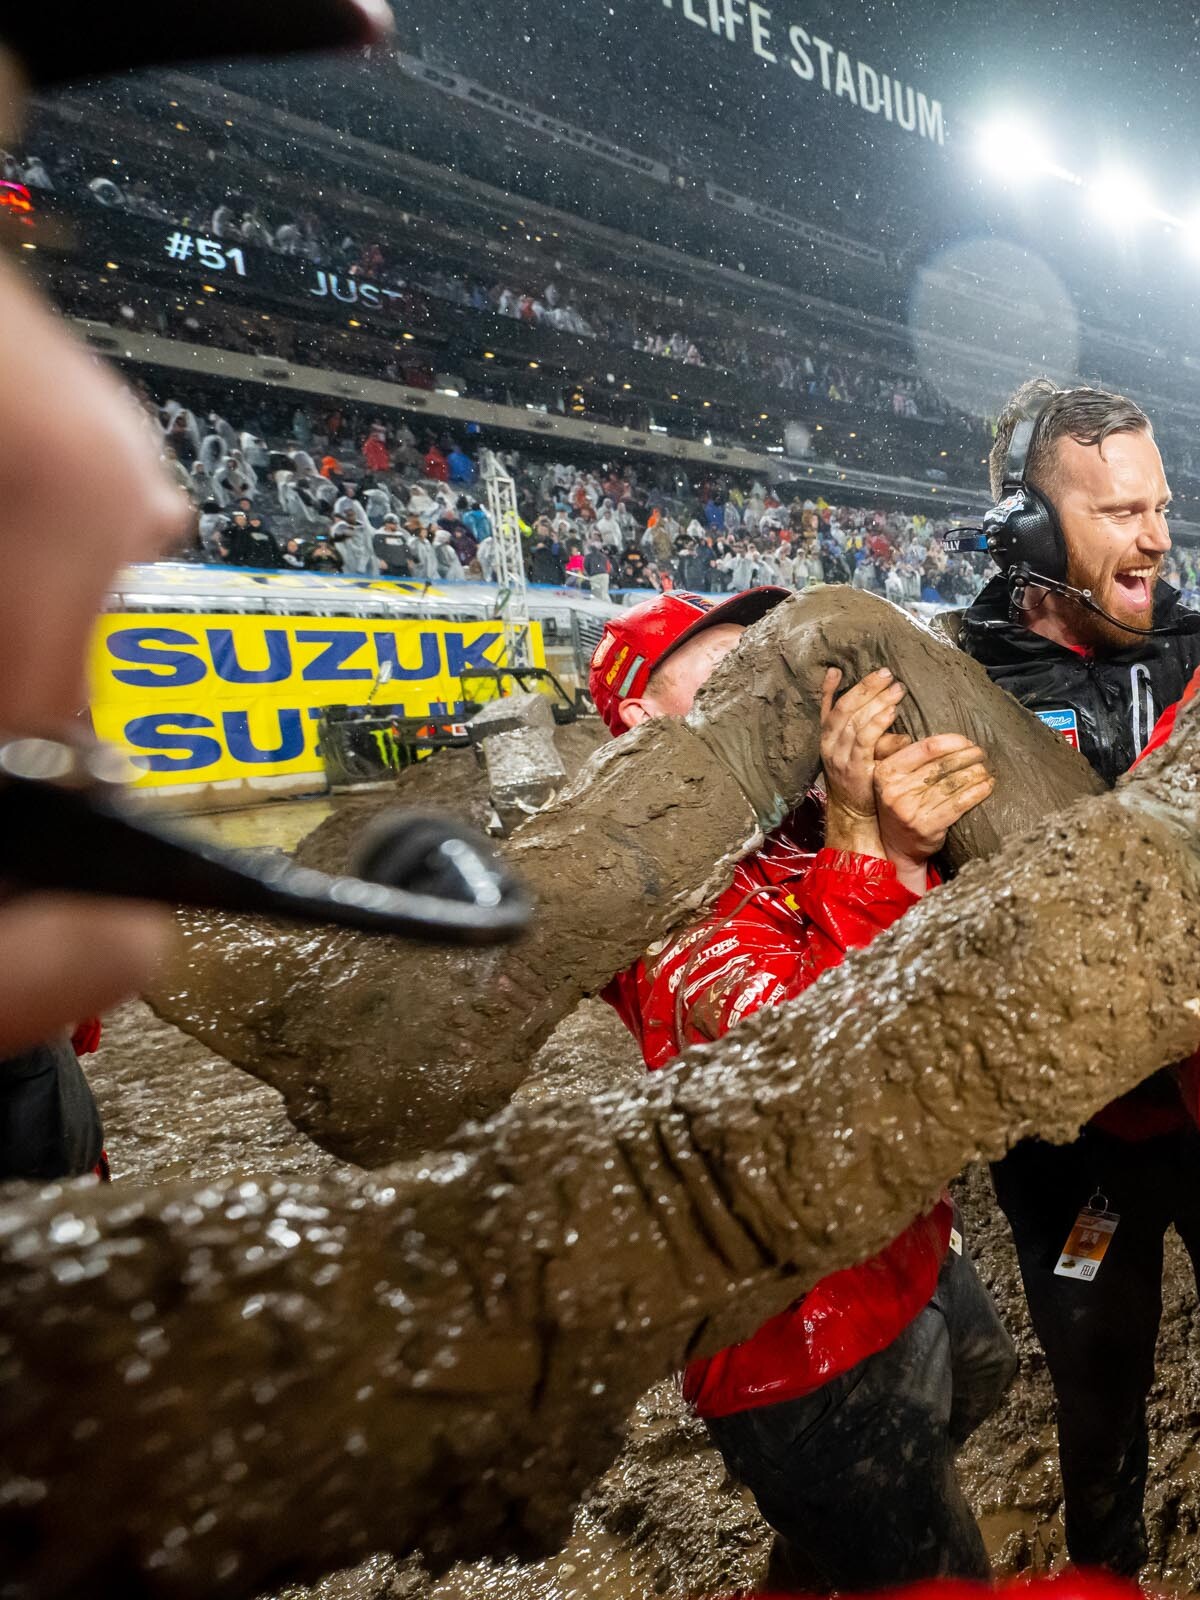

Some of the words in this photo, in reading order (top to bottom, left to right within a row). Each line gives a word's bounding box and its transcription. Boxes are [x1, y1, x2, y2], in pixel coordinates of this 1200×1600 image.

[663, 0, 778, 64] LIFE
[789, 25, 944, 146] STADIUM
[164, 232, 246, 276] #51
[106, 627, 526, 688] SUZUK
